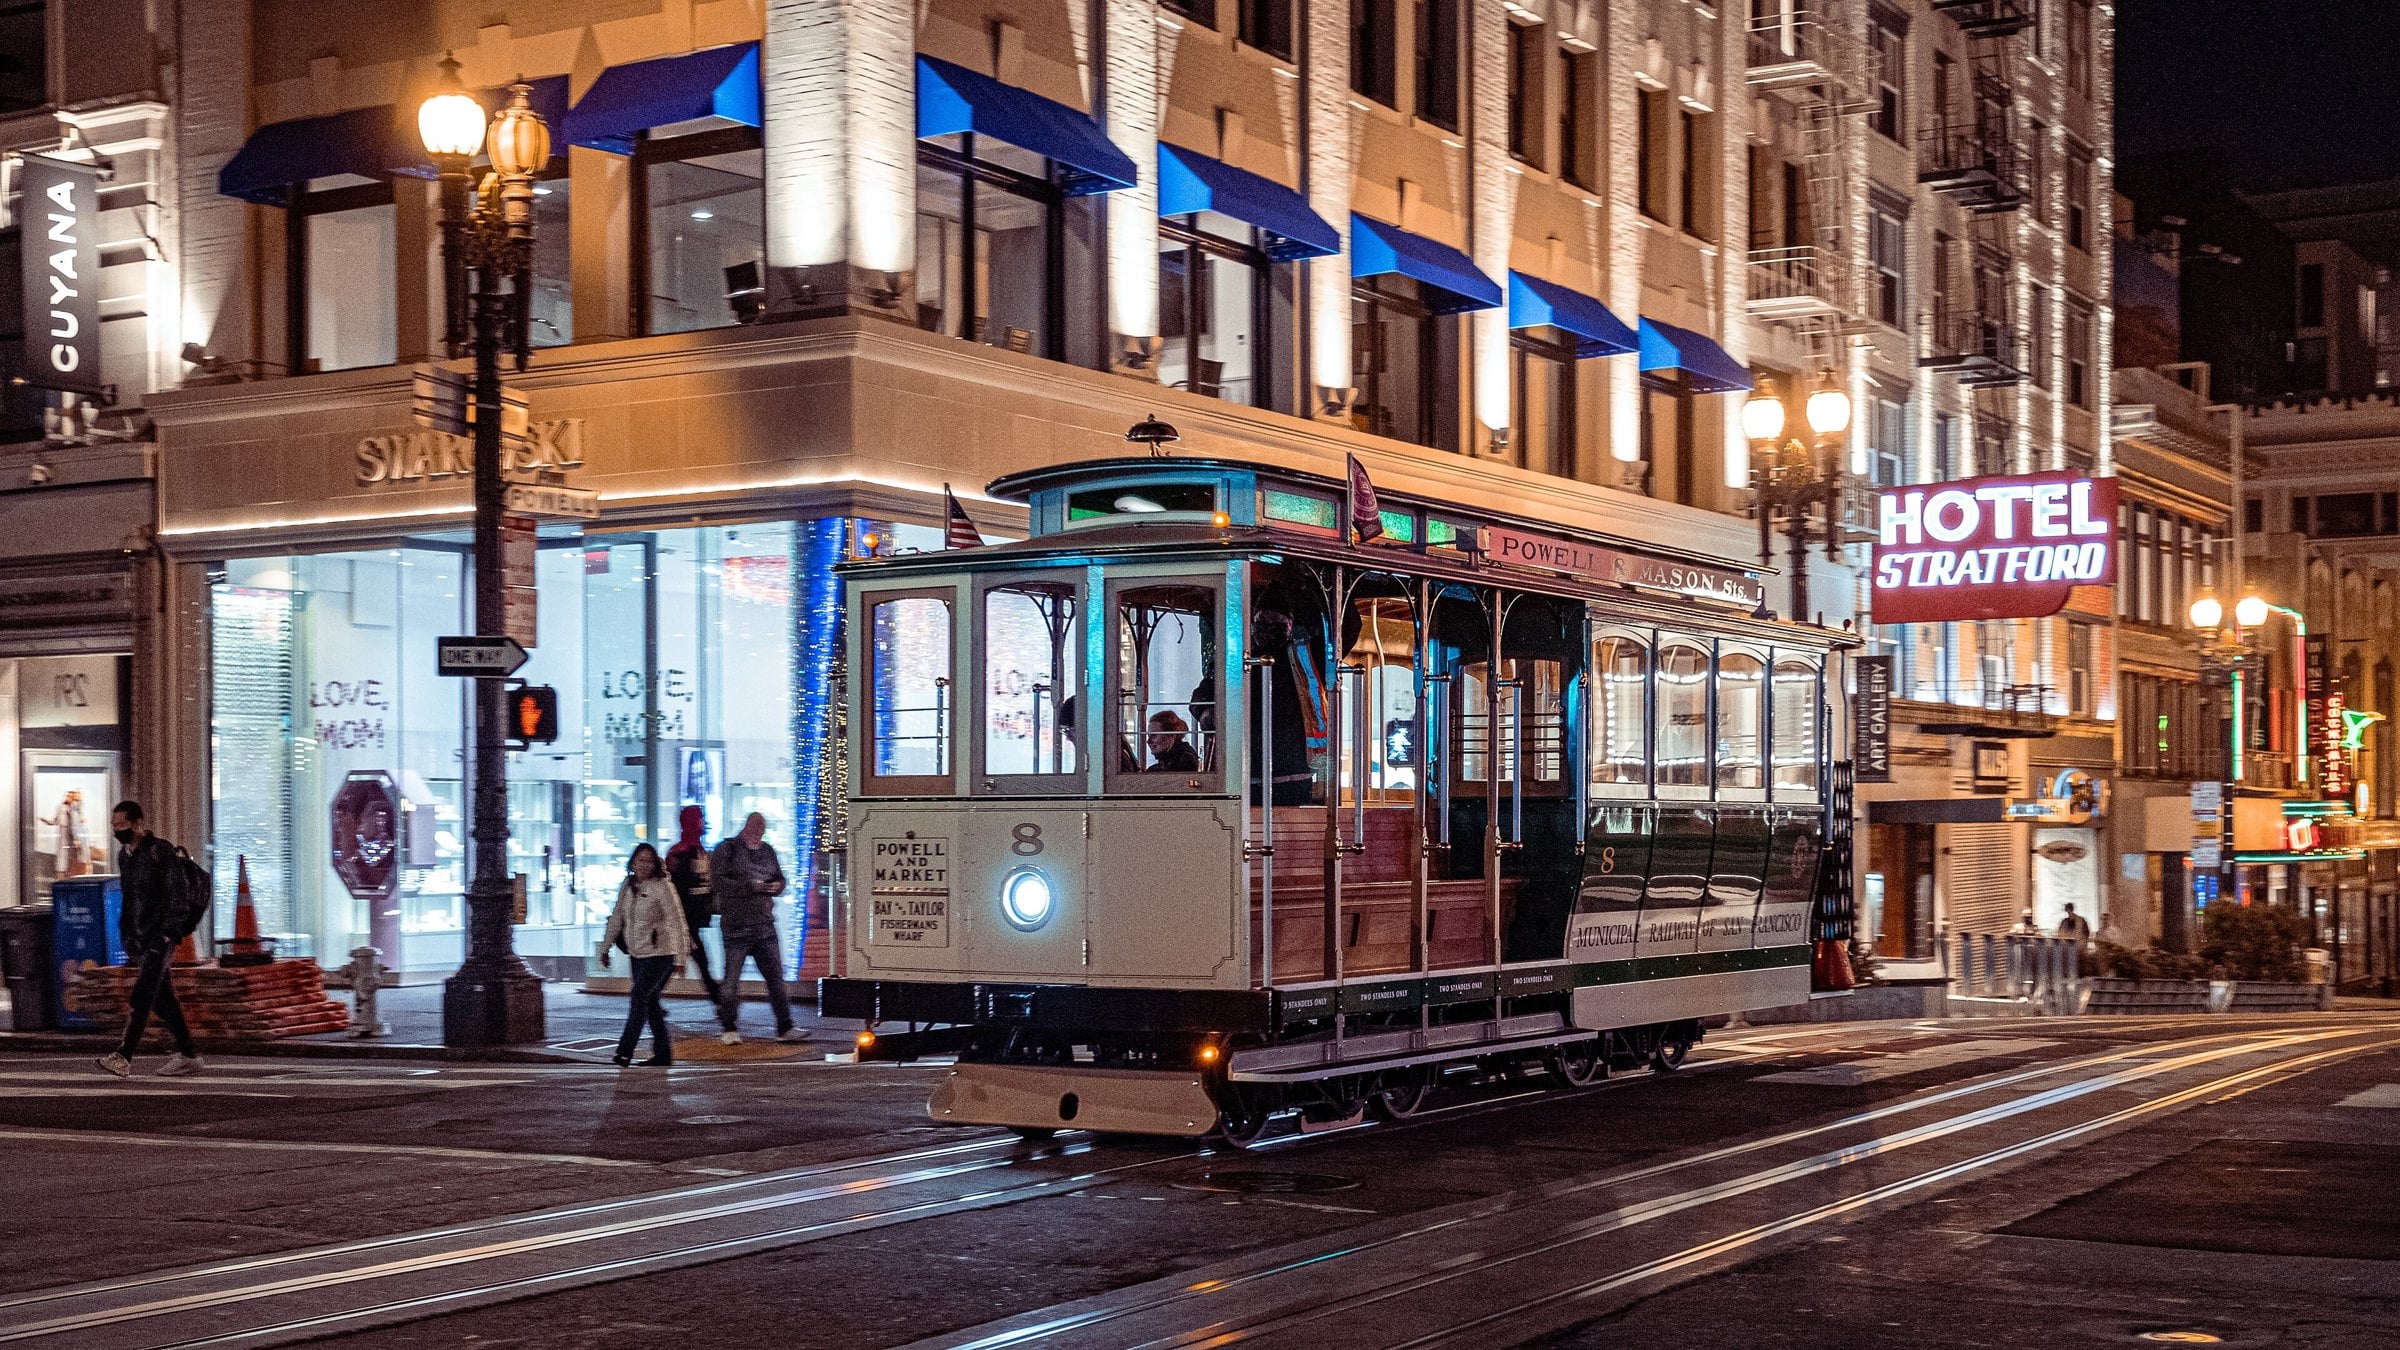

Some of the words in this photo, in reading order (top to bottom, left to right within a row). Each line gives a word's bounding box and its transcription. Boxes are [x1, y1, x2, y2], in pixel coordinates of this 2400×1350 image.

[47, 182, 79, 372] CUYANA
[511, 487, 594, 514] POWELL
[1879, 481, 2108, 546] HOTEL
[1501, 536, 1594, 570] POWELL
[1638, 566, 1715, 591] MASON
[1723, 579, 1748, 599] Sts.
[1875, 543, 2107, 589] STRATFORD
[446, 650, 472, 664] ONE
[475, 650, 503, 664] WAY
[1870, 663, 1887, 735] GALLERY
[1870, 739, 1887, 771] ART
[1012, 823, 1045, 856] 8
[877, 843, 945, 856] POWELL
[894, 857, 929, 867] AND
[1601, 847, 1616, 874] 8
[875, 869, 947, 882] MARKET
[874, 901, 892, 916] BAY
[908, 901, 945, 916] TAYLOR
[880, 919, 939, 930] FISHERMANS
[1576, 922, 1642, 948] MUNICIPAL
[1649, 919, 1697, 943] RAILWAY
[1702, 918, 1718, 937] OF
[1722, 914, 1743, 937] SAN
[1751, 912, 1802, 935] FRANCISCO
[893, 931, 924, 942] WHARF
[1513, 976, 1523, 985] TWO
[1543, 973, 1553, 983] ONLY
[1439, 984, 1449, 993] TWO
[1472, 981, 1483, 990] ONLY
[1360, 992, 1371, 1001] TWO
[1372, 990, 1395, 1000] STANDEES
[1395, 989, 1408, 998] ONLY
[1288, 999, 1313, 1009] STANDEES
[1314, 997, 1327, 1006] ONLY
